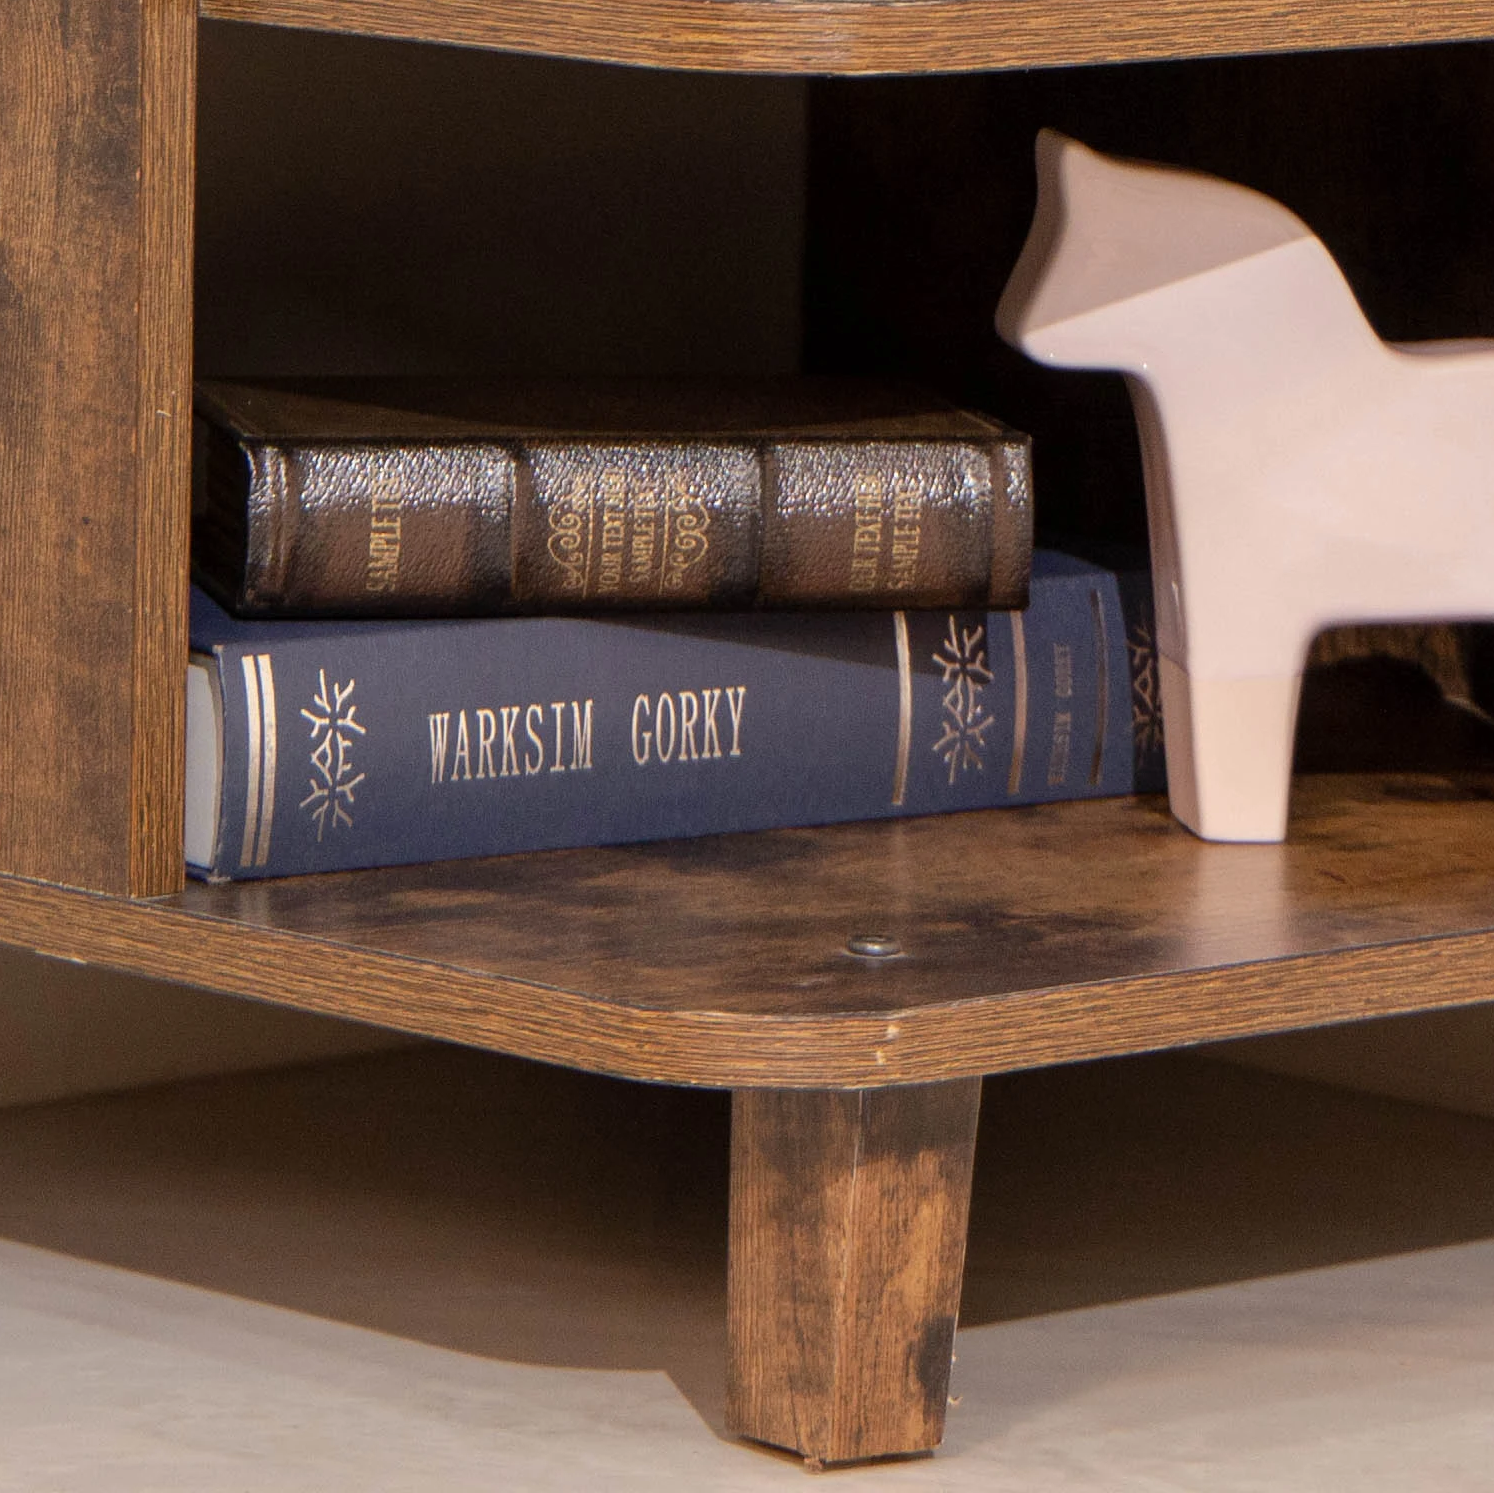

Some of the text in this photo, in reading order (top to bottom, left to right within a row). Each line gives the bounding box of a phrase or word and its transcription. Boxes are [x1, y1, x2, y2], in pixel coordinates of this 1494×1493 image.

[366, 516, 402, 593] SAMPLE
[428, 686, 747, 785] WARKSIM GORKY
